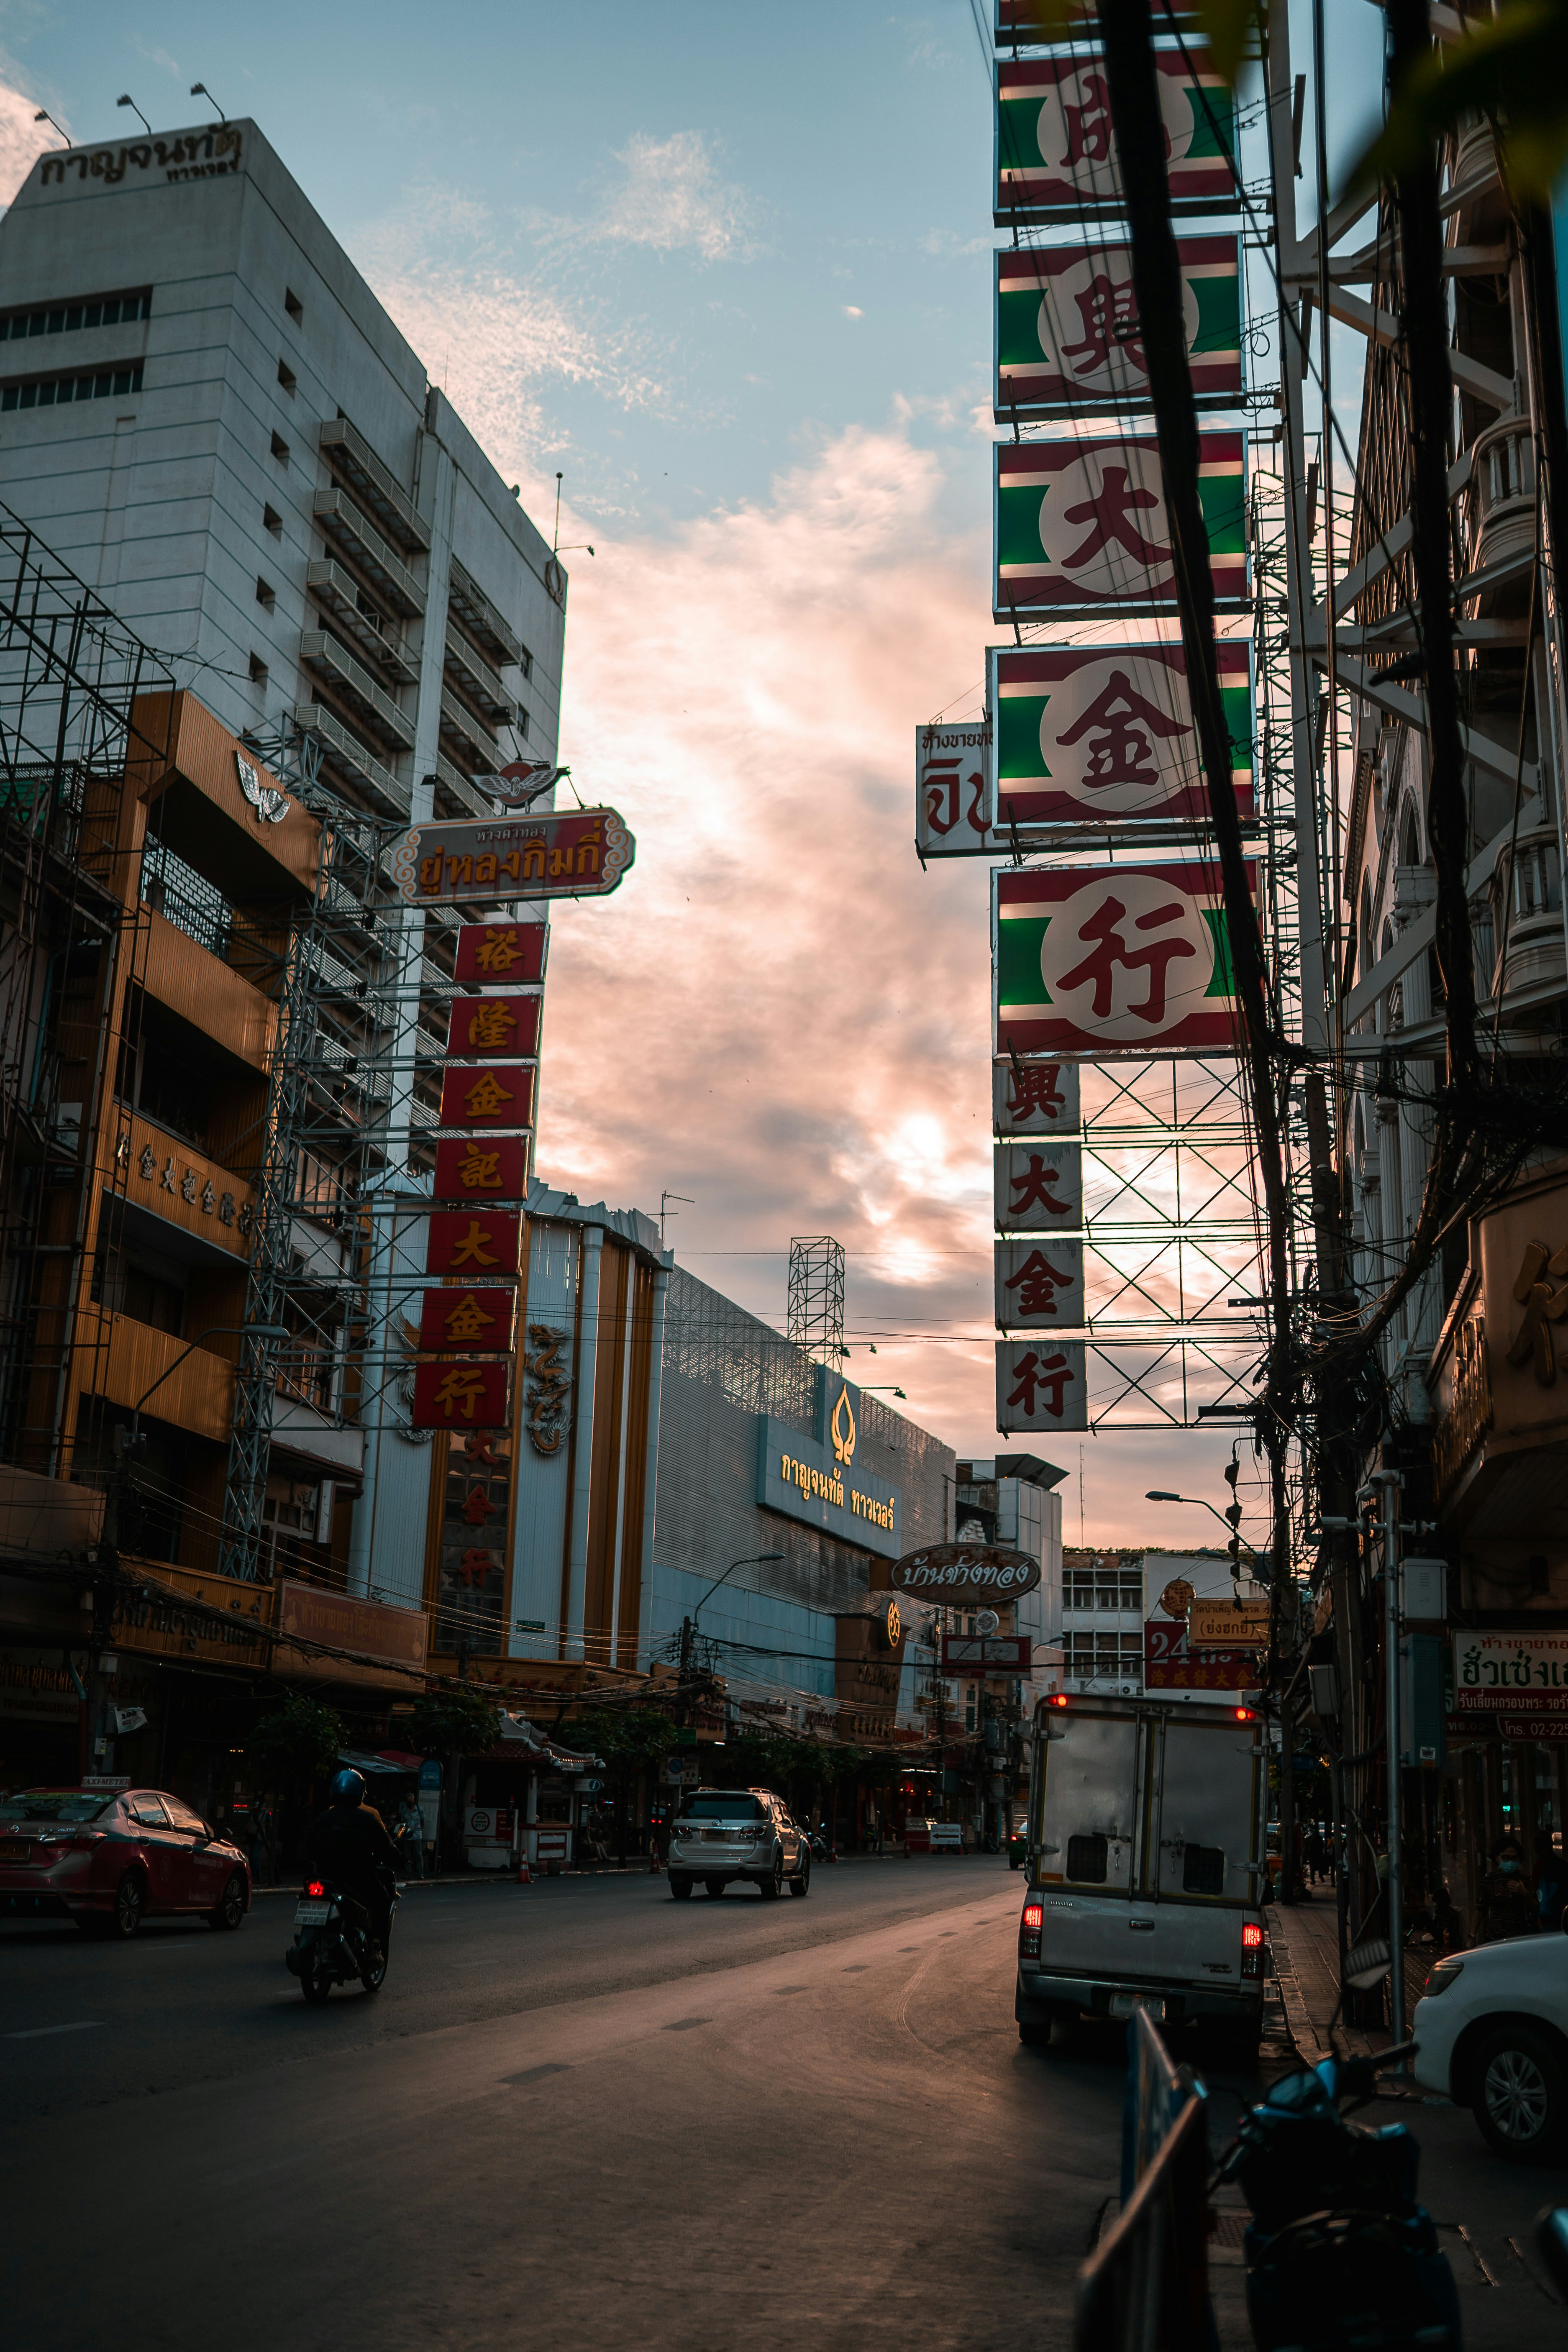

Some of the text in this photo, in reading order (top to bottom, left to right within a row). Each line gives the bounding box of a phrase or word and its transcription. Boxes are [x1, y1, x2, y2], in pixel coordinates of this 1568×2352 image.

[476, 825, 547, 843] ห้างค้าทอง
[420, 819, 601, 894] ยู่หลงกิมกี่
[781, 1454, 895, 1530] กาญจนทัต ทาวเวอร์
[1194, 1603, 1260, 1616] วัดบำเพ็ญจีพรต
[1151, 1632, 1190, 1664] 24
[1459, 1689, 1543, 1709] รับเลี่ยมกรอบพระ
